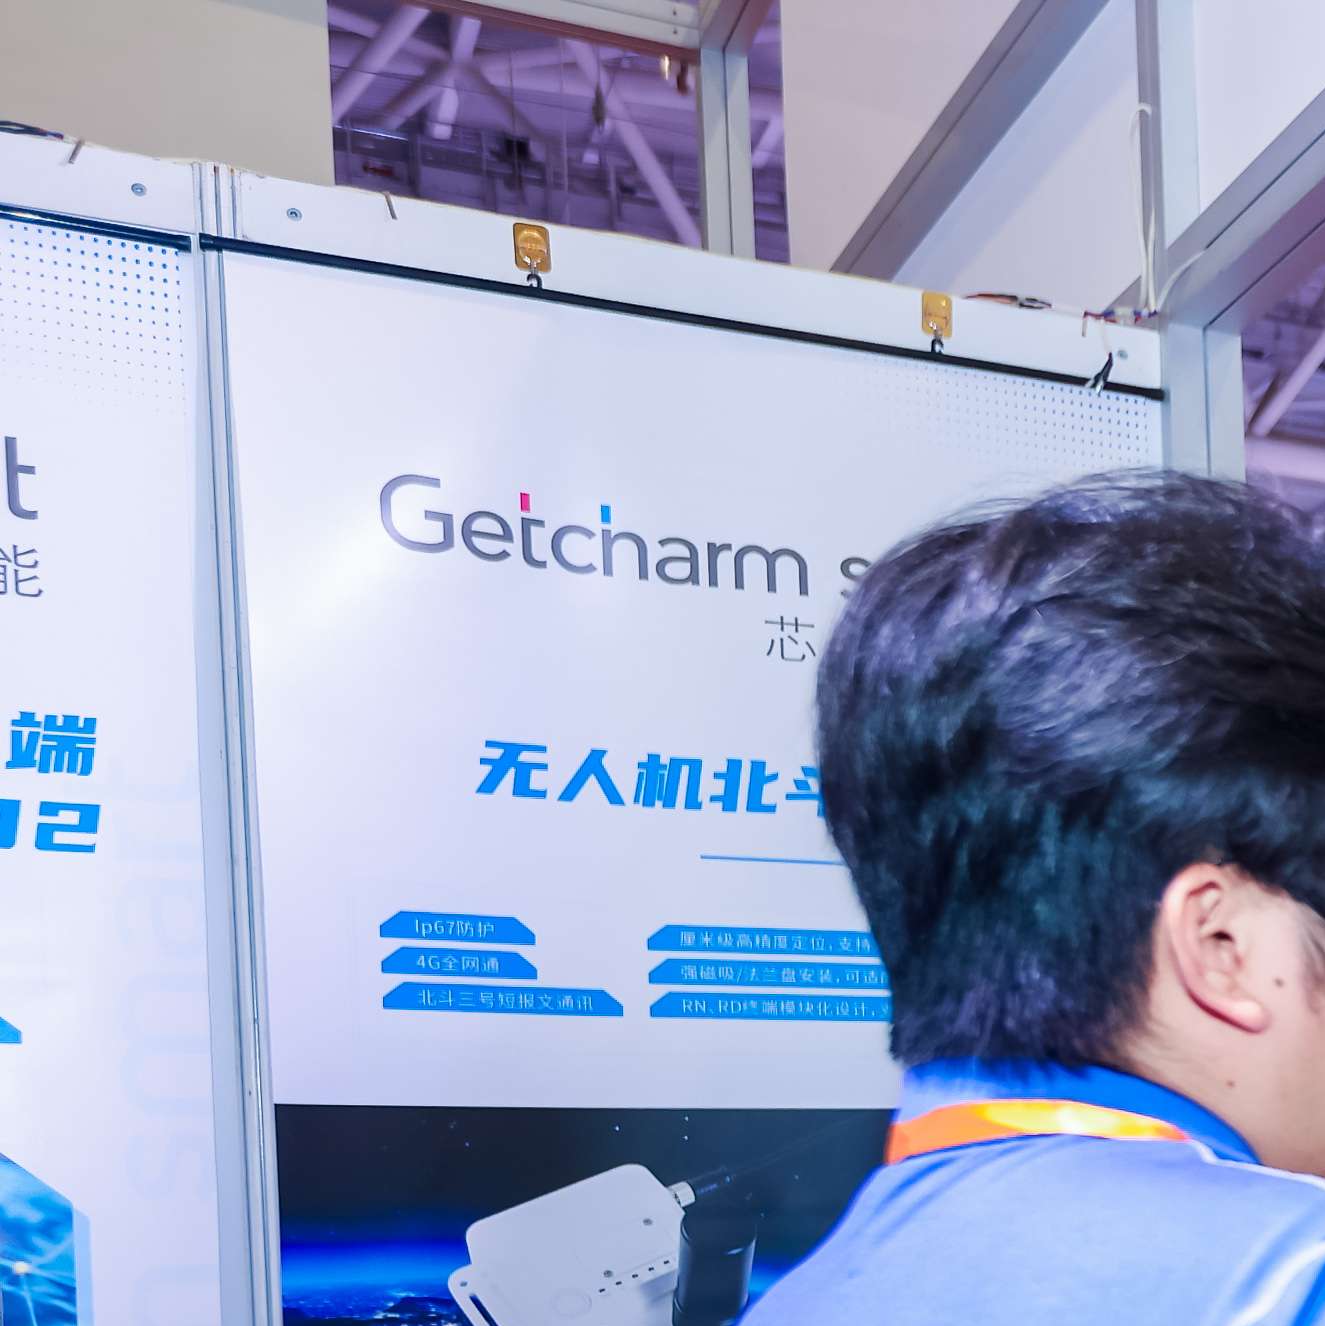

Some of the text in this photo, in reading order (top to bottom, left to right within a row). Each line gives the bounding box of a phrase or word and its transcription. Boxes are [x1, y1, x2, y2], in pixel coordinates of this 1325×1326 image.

[380, 474, 809, 597] Getcharm
[416, 954, 500, 973] 4G全网通
[417, 988, 594, 1012] 北斗三号短报文通讯
